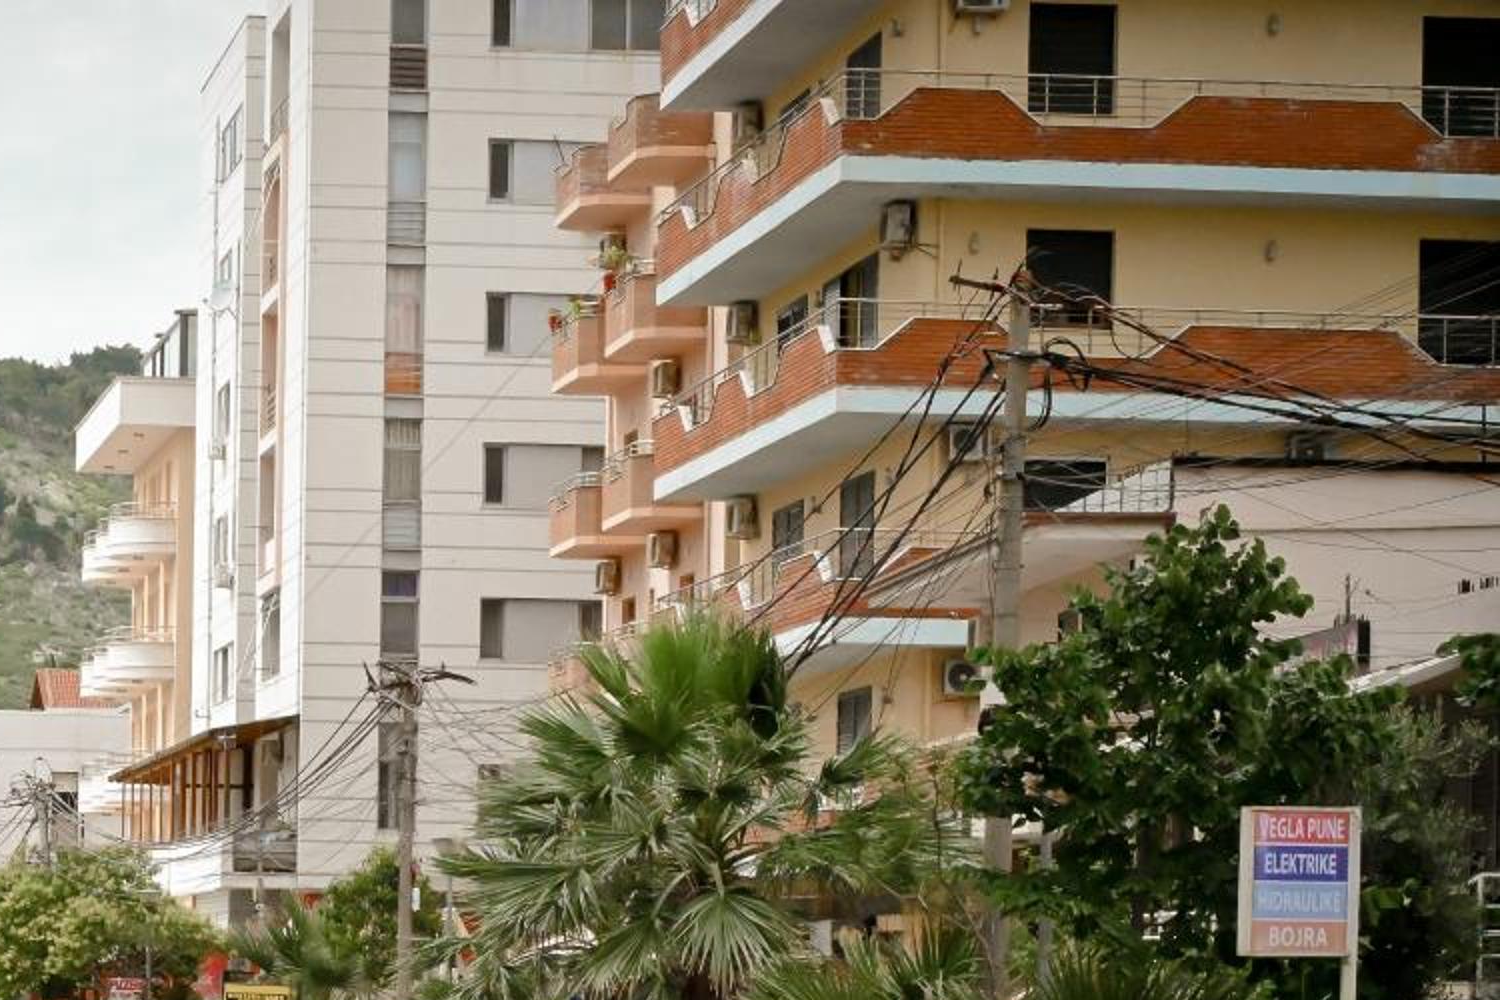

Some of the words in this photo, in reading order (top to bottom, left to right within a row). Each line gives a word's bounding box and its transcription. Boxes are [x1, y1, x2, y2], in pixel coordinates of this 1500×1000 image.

[1258, 813, 1305, 838] VEGLA
[1308, 816, 1346, 839] PUNE
[1264, 852, 1338, 875] ELEKTRIKE
[1269, 926, 1328, 948] BOJRA
